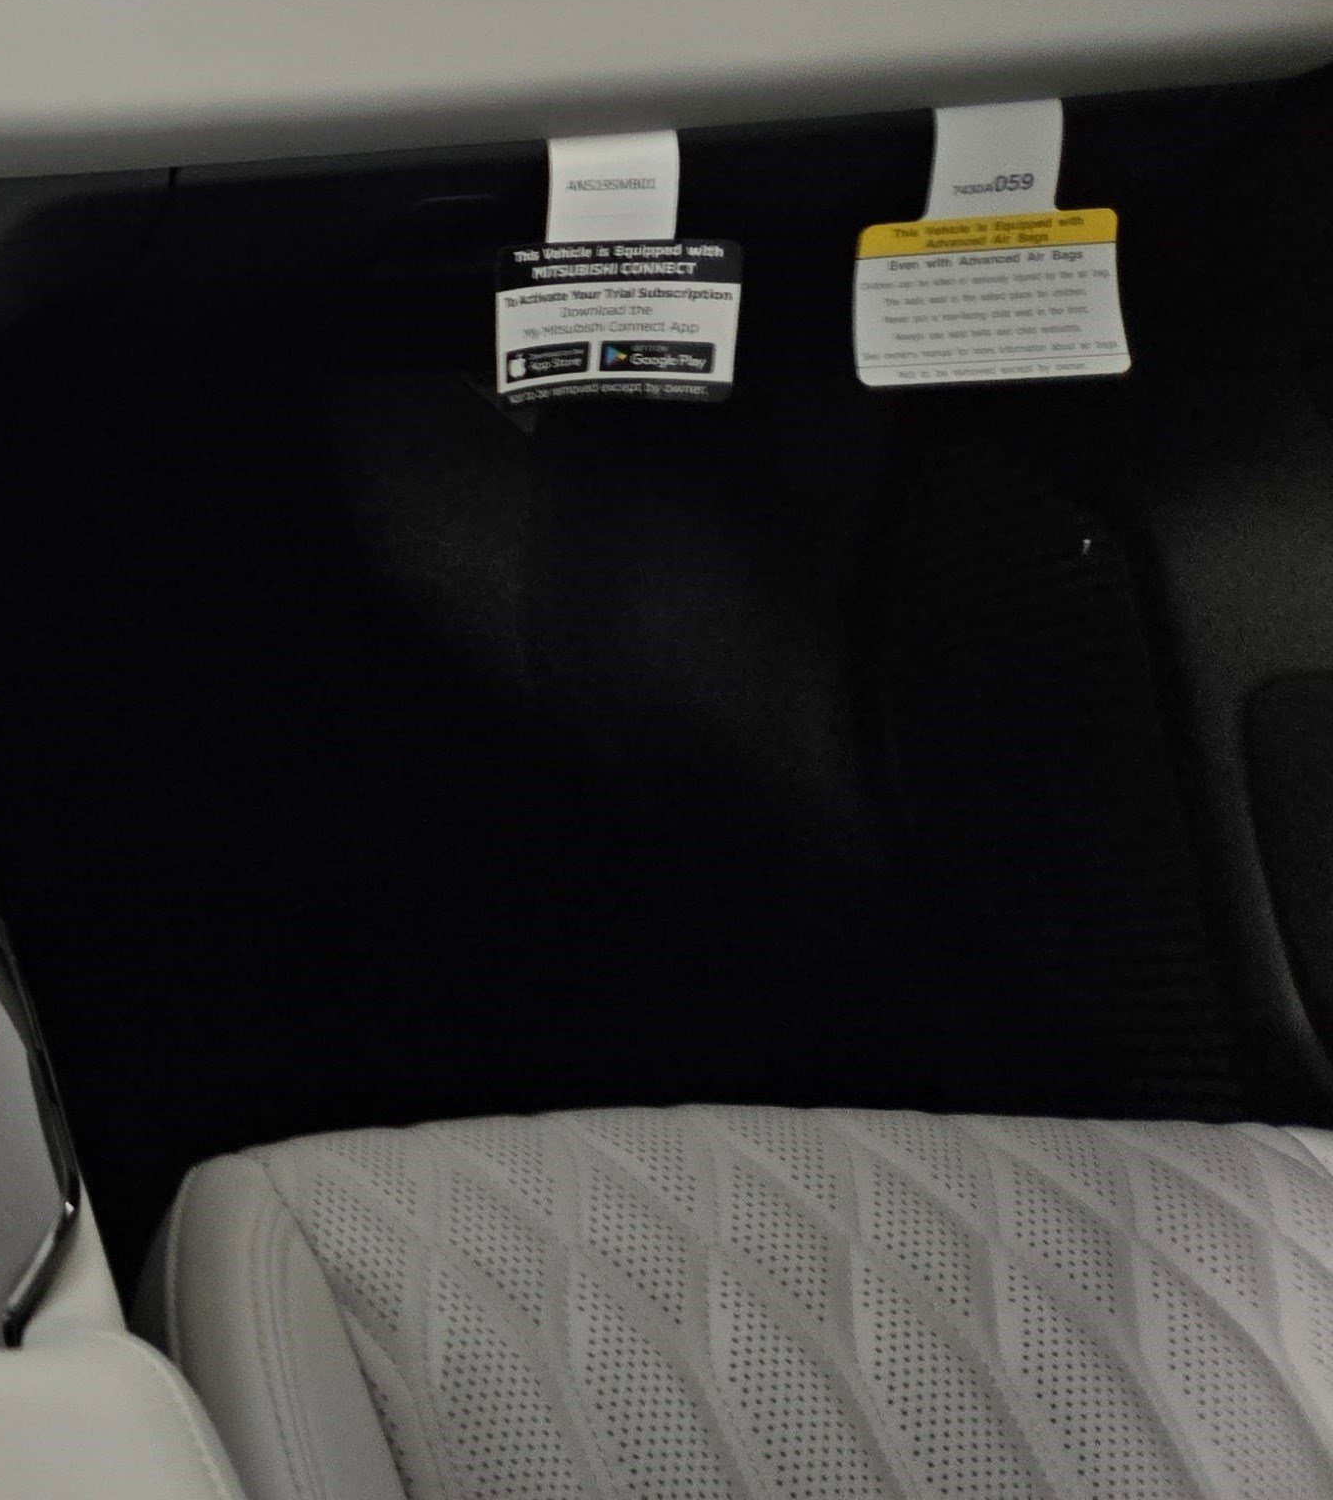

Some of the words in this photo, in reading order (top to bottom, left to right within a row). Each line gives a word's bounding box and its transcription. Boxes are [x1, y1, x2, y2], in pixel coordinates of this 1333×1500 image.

[994, 218, 1053, 233] Equipped
[1058, 216, 1085, 227] with
[513, 249, 540, 263] This
[543, 247, 593, 260] Vehicle
[596, 245, 610, 257] is
[613, 244, 683, 260] Equipped
[686, 244, 724, 258] with
[889, 260, 920, 271] Even
[926, 257, 953, 268] with
[958, 254, 1021, 267] Advanced
[1026, 251, 1045, 262] Air
[1052, 250, 1084, 263] Bags
[531, 262, 619, 280] MITSUBISHI
[620, 262, 696, 275] CONNECT
[572, 290, 601, 301] Your
[603, 287, 636, 299] Trial
[637, 287, 733, 303] Subscription
[559, 304, 626, 319] Download
[626, 304, 653, 316] the
[670, 321, 700, 335] App
[629, 353, 679, 369] Google
[679, 354, 707, 370] Play
